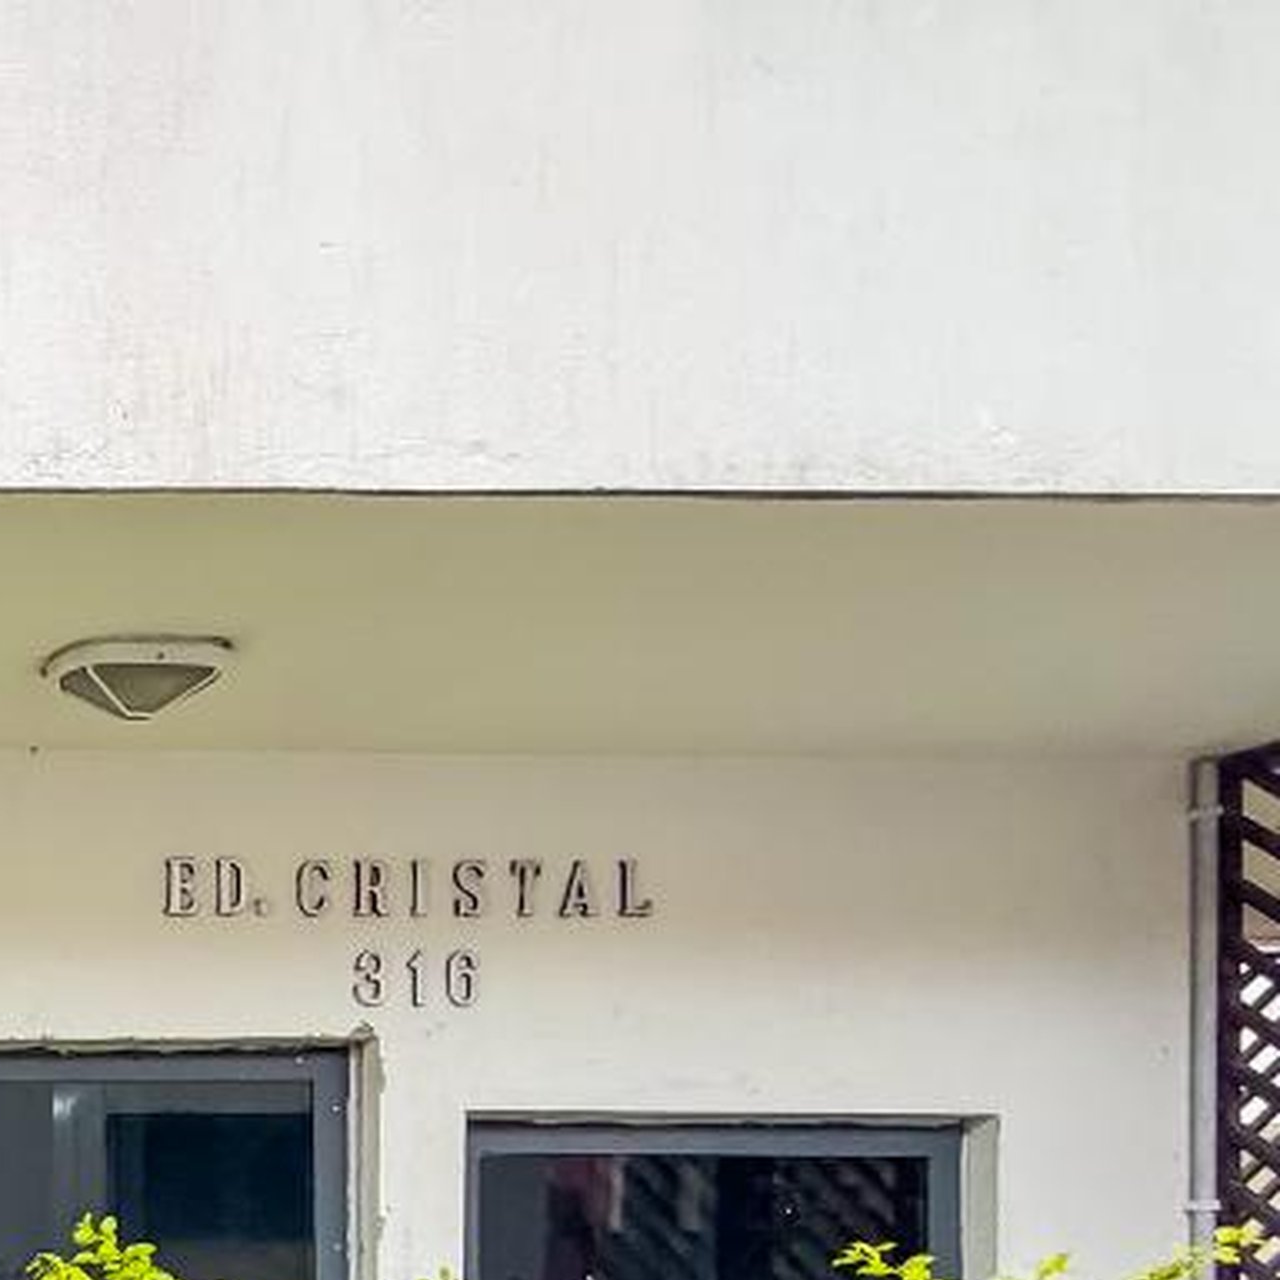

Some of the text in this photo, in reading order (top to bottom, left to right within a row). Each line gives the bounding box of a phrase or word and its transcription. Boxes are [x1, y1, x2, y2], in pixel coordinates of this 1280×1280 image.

[161, 857, 654, 919] ED. CRISTAL
[351, 949, 479, 1008] 316
